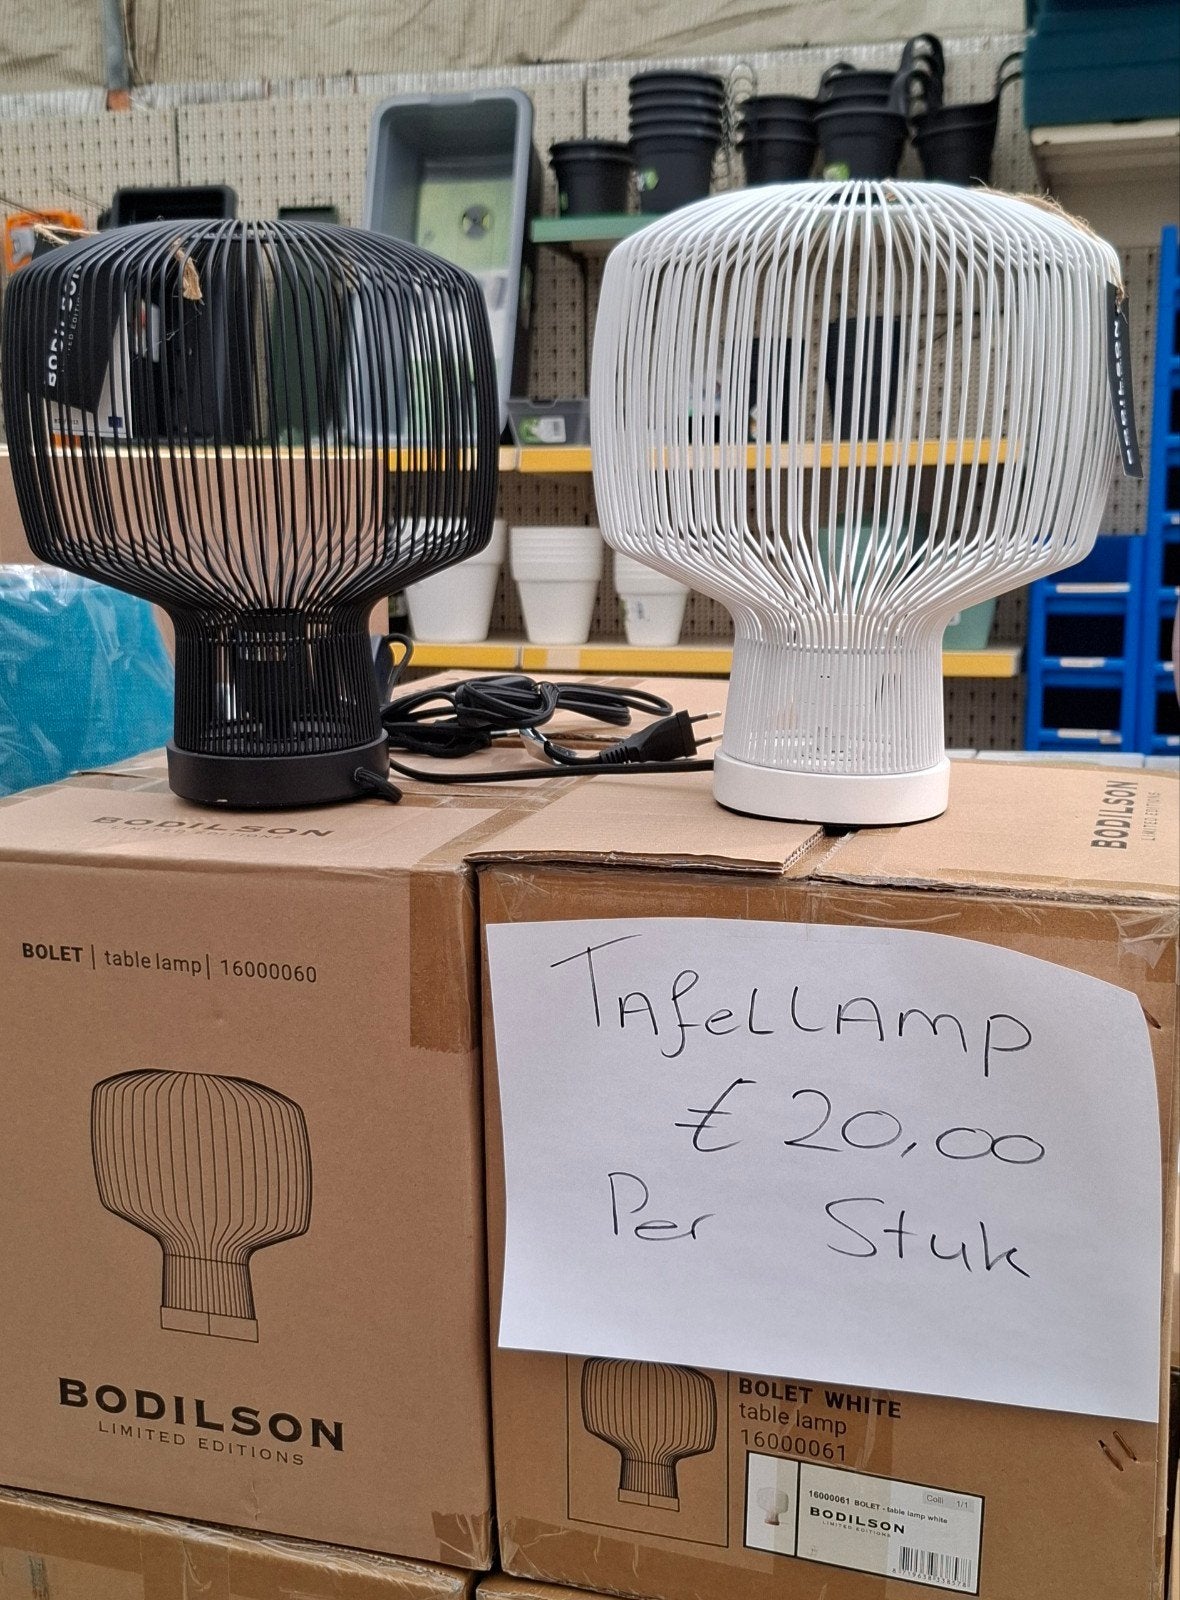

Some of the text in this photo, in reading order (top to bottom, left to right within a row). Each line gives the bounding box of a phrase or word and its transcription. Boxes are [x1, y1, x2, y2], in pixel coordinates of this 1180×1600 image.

[91, 816, 334, 837] BODILSON
[1090, 780, 1139, 849] BODILSON
[22, 942, 83, 963] BOLET
[104, 949, 151, 969] table
[156, 952, 202, 977] lamp
[220, 958, 317, 983] 16000060
[784, 1089, 1046, 1164] 20,00
[608, 1171, 1032, 1278] Per Stuk
[58, 1376, 345, 1452] BODILSON
[738, 1376, 902, 1419] BOLET WHITE
[738, 1402, 847, 1438] table lamp
[98, 1420, 305, 1466] LIMITED EDITIONS
[740, 1428, 846, 1461] 16000061
[808, 1489, 851, 1505] 16000061
[854, 1499, 881, 1511] BOLET
[887, 1506, 906, 1516] table
[907, 1511, 926, 1521] lamp
[927, 1515, 948, 1524] white
[809, 1506, 906, 1535] BODILSON
[956, 1500, 969, 1509] 1/1
[822, 1520, 853, 1530] LIMITED
